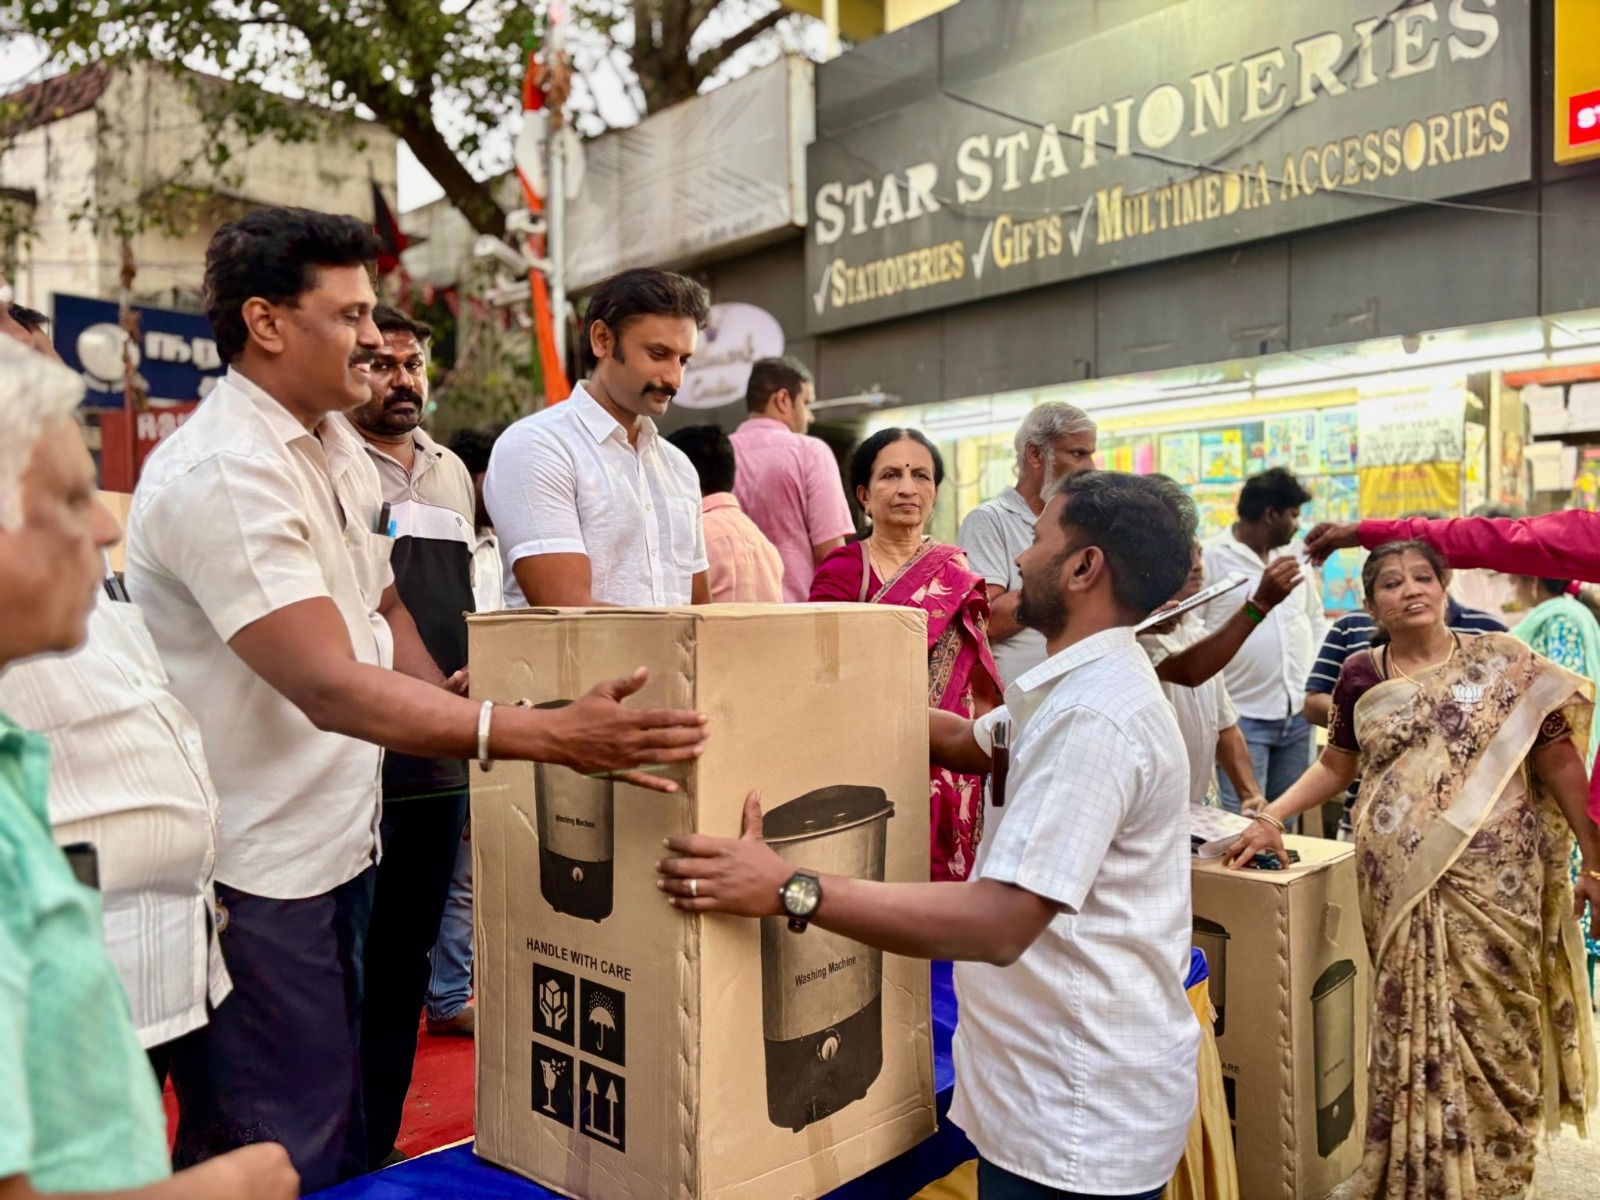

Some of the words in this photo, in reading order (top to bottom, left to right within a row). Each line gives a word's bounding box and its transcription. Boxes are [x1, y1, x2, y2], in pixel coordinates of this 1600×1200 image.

[814, 162, 941, 246] STAR
[956, 0, 1499, 204] STATIONERIES
[830, 240, 965, 308] STATIONERIES
[992, 213, 1062, 268] GIFTS
[1096, 160, 1271, 245] MULTIMEDIA
[1280, 99, 1510, 201] ACCESSORIES
[555, 814, 575, 827] Washing
[575, 817, 595, 828] Machine
[526, 937, 568, 961] HANDLE
[571, 950, 598, 970] WITH
[600, 960, 632, 981] CARE
[795, 968, 827, 987] Washing
[828, 956, 857, 974] Machine
[1222, 1062, 1240, 1074] ARE
